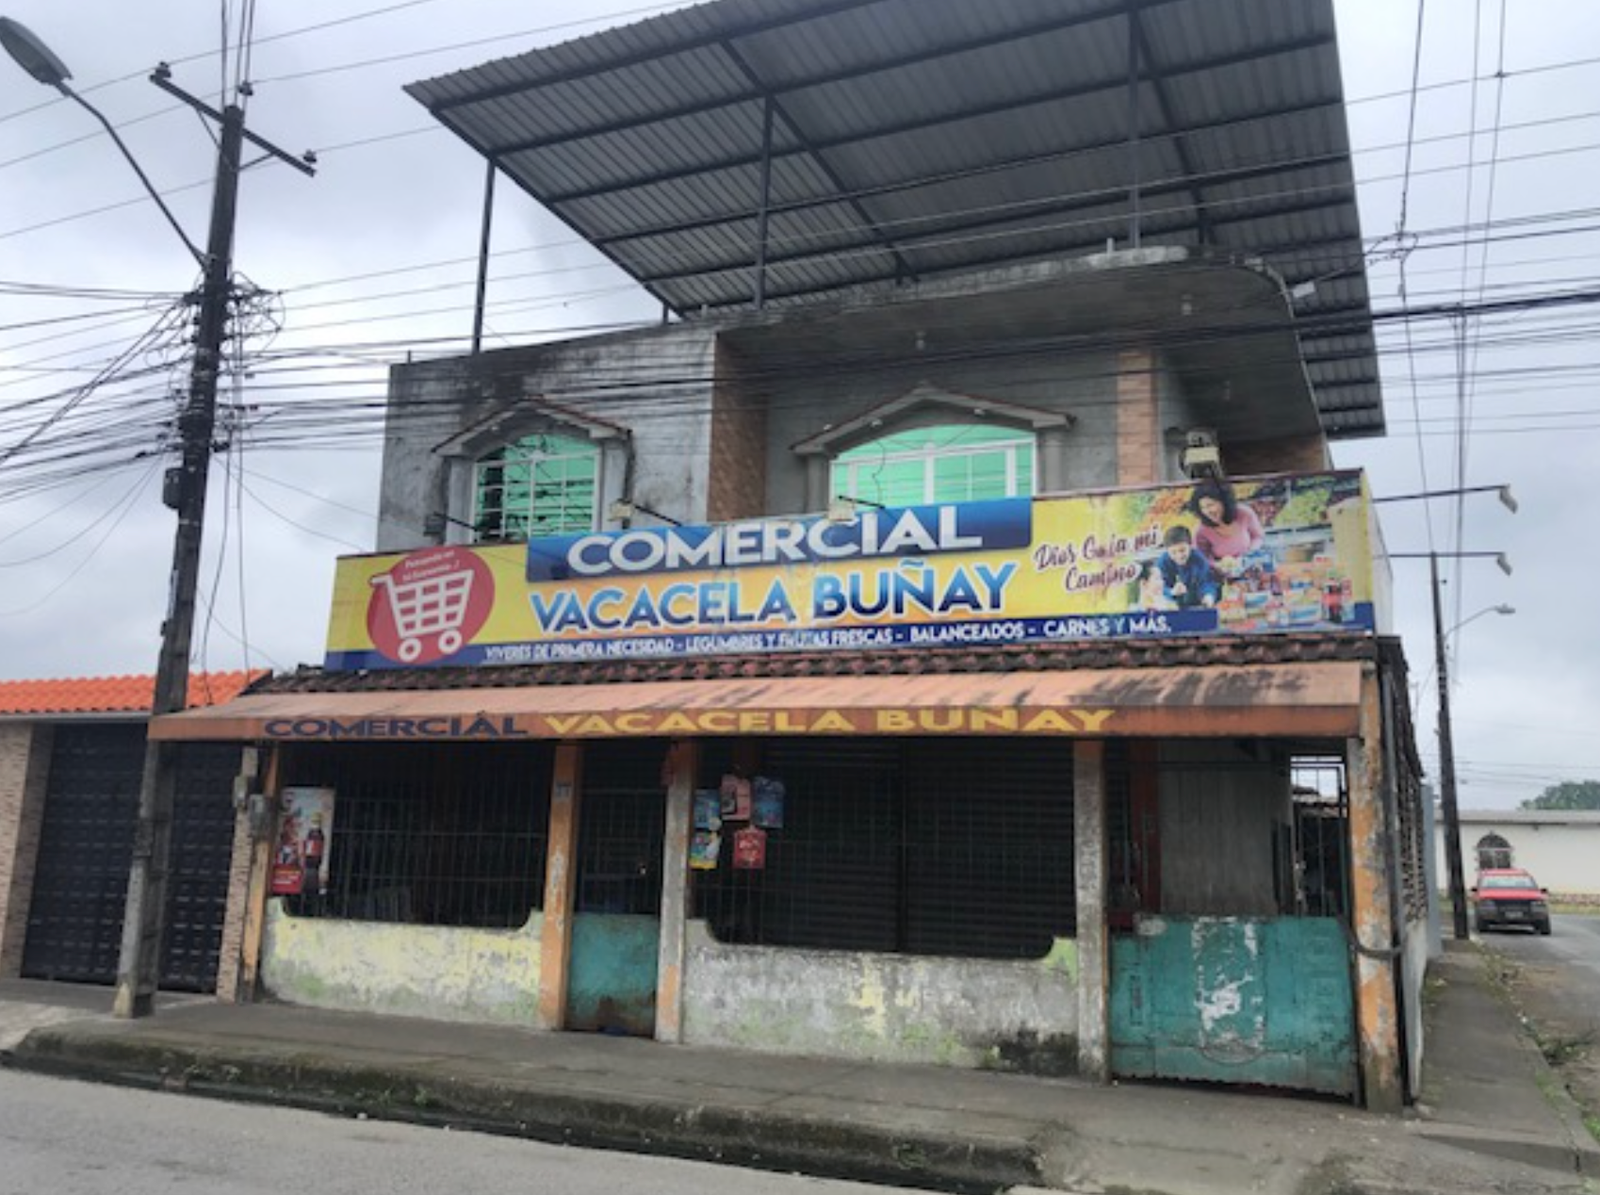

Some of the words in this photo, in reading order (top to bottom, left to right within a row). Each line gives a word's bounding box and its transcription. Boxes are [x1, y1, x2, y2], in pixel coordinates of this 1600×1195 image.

[567, 506, 983, 574] COMERCIAL
[1034, 542, 1076, 571] Dios
[1065, 562, 1137, 592] Camino
[530, 573, 795, 633] VACACELA
[811, 559, 1018, 619] BUÑAY
[607, 638, 674, 656] NECESIDAD
[767, 633, 776, 647] Y
[833, 627, 893, 646] FRESCAS
[911, 621, 1024, 643] BALANCEADOS
[1044, 618, 1110, 637] CARNES
[1115, 618, 1126, 634] Y
[543, 708, 855, 735] VACACELA
